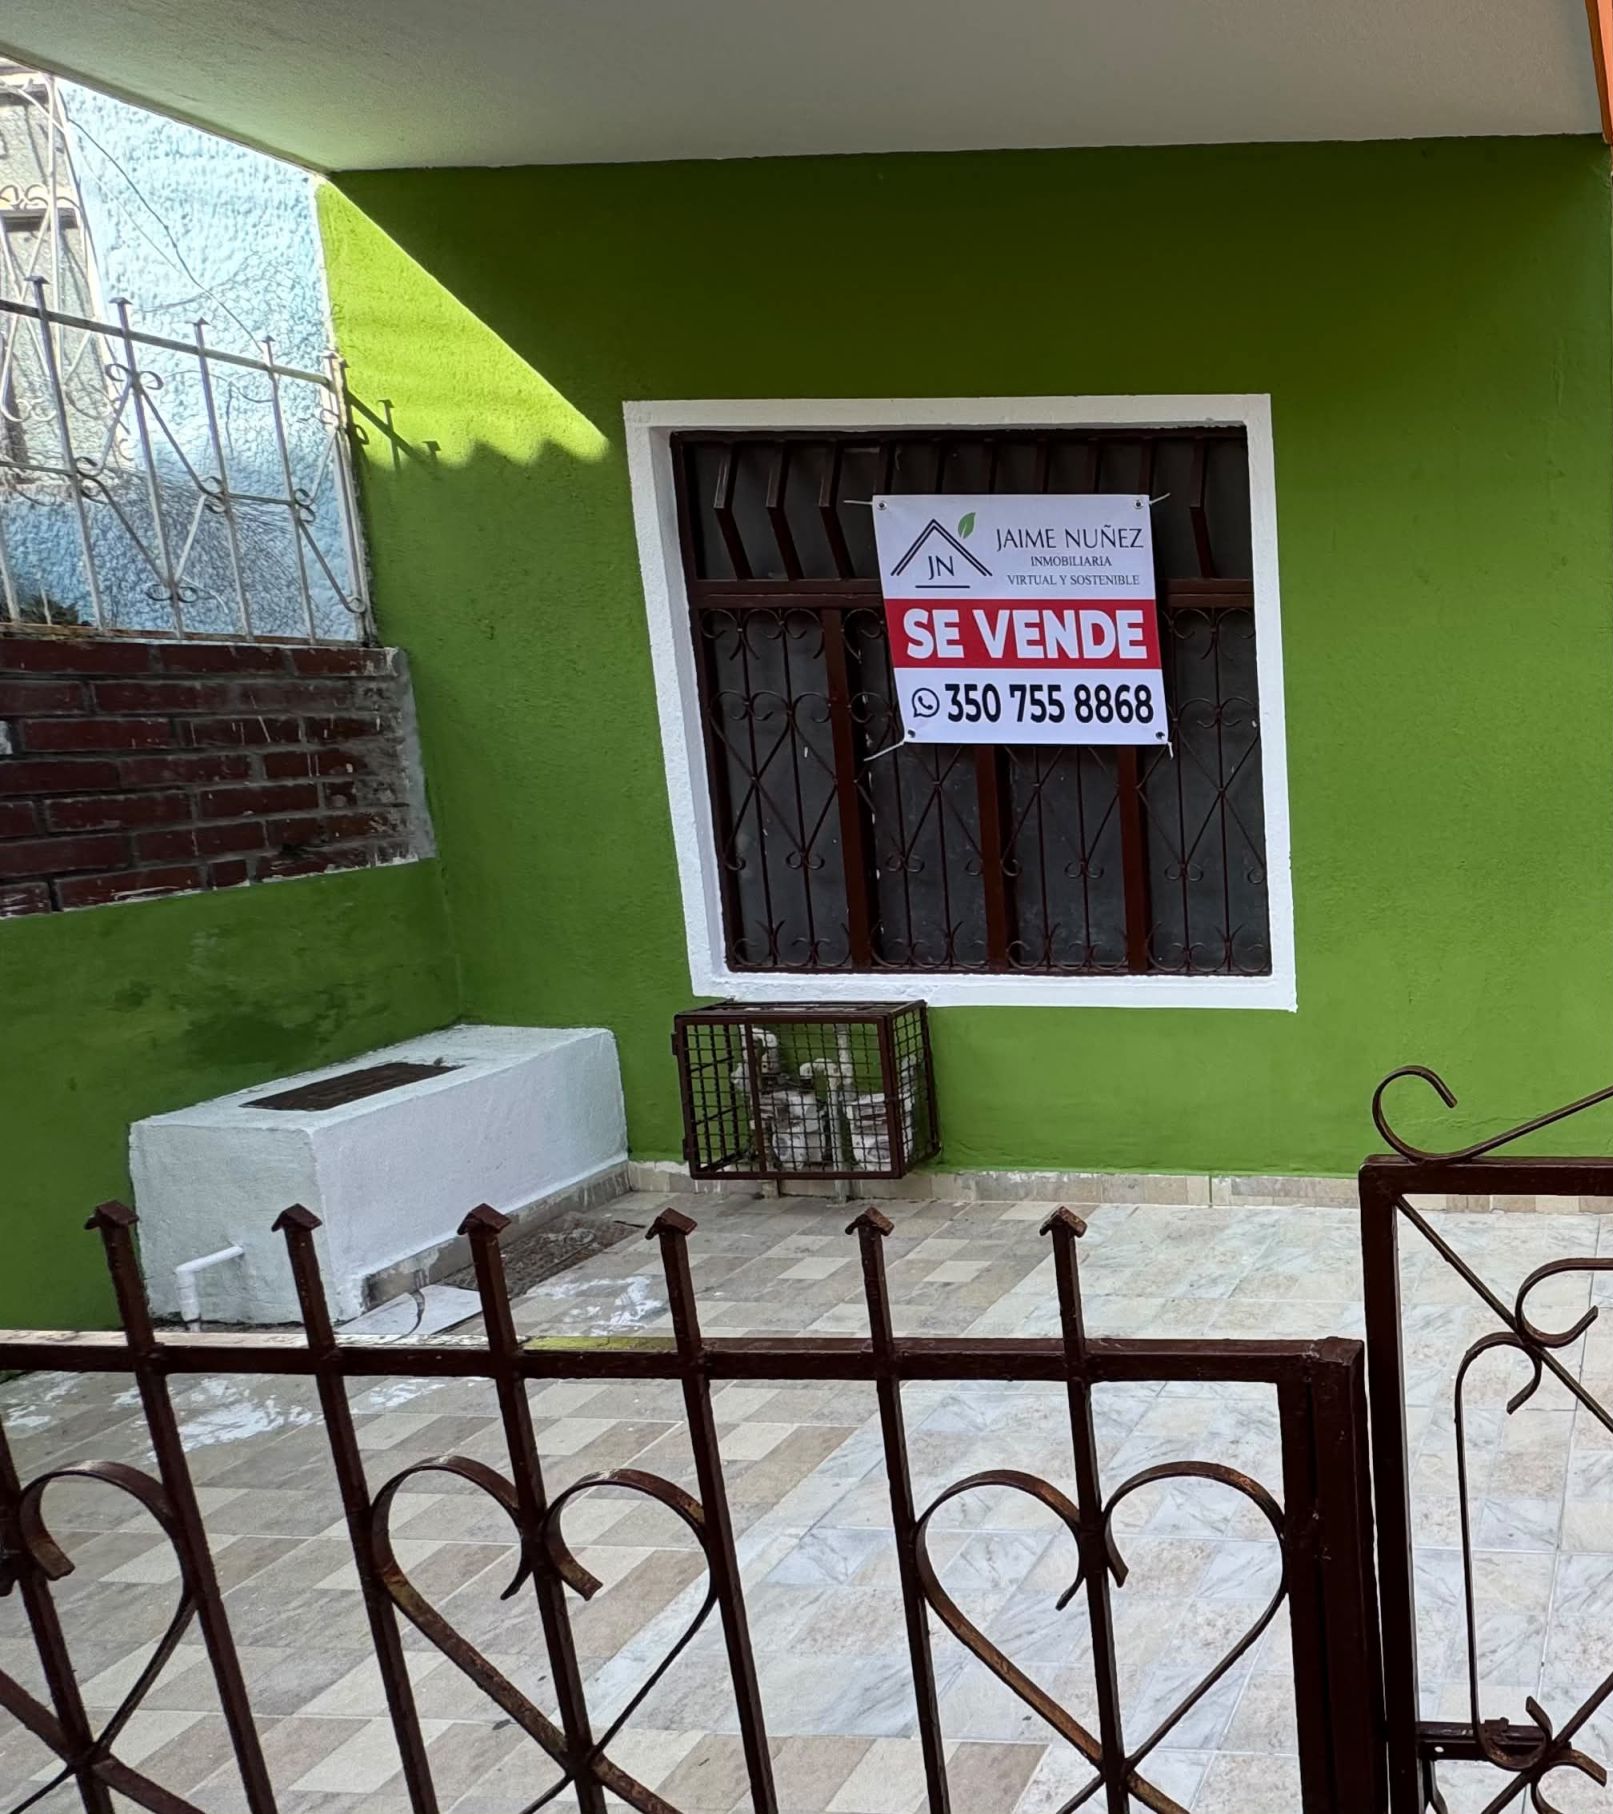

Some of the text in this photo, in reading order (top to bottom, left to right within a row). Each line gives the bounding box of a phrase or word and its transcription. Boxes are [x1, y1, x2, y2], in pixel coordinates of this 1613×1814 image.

[997, 524, 1144, 552] JAIME NUÑEZ
[928, 555, 955, 580] JN
[1031, 556, 1112, 568] INMOBILIARIA
[1007, 574, 1140, 586] VIRTUAL Y SOSTENIBLE
[903, 608, 1148, 659] SE VENDE
[944, 683, 1154, 724] 350 755 8868
